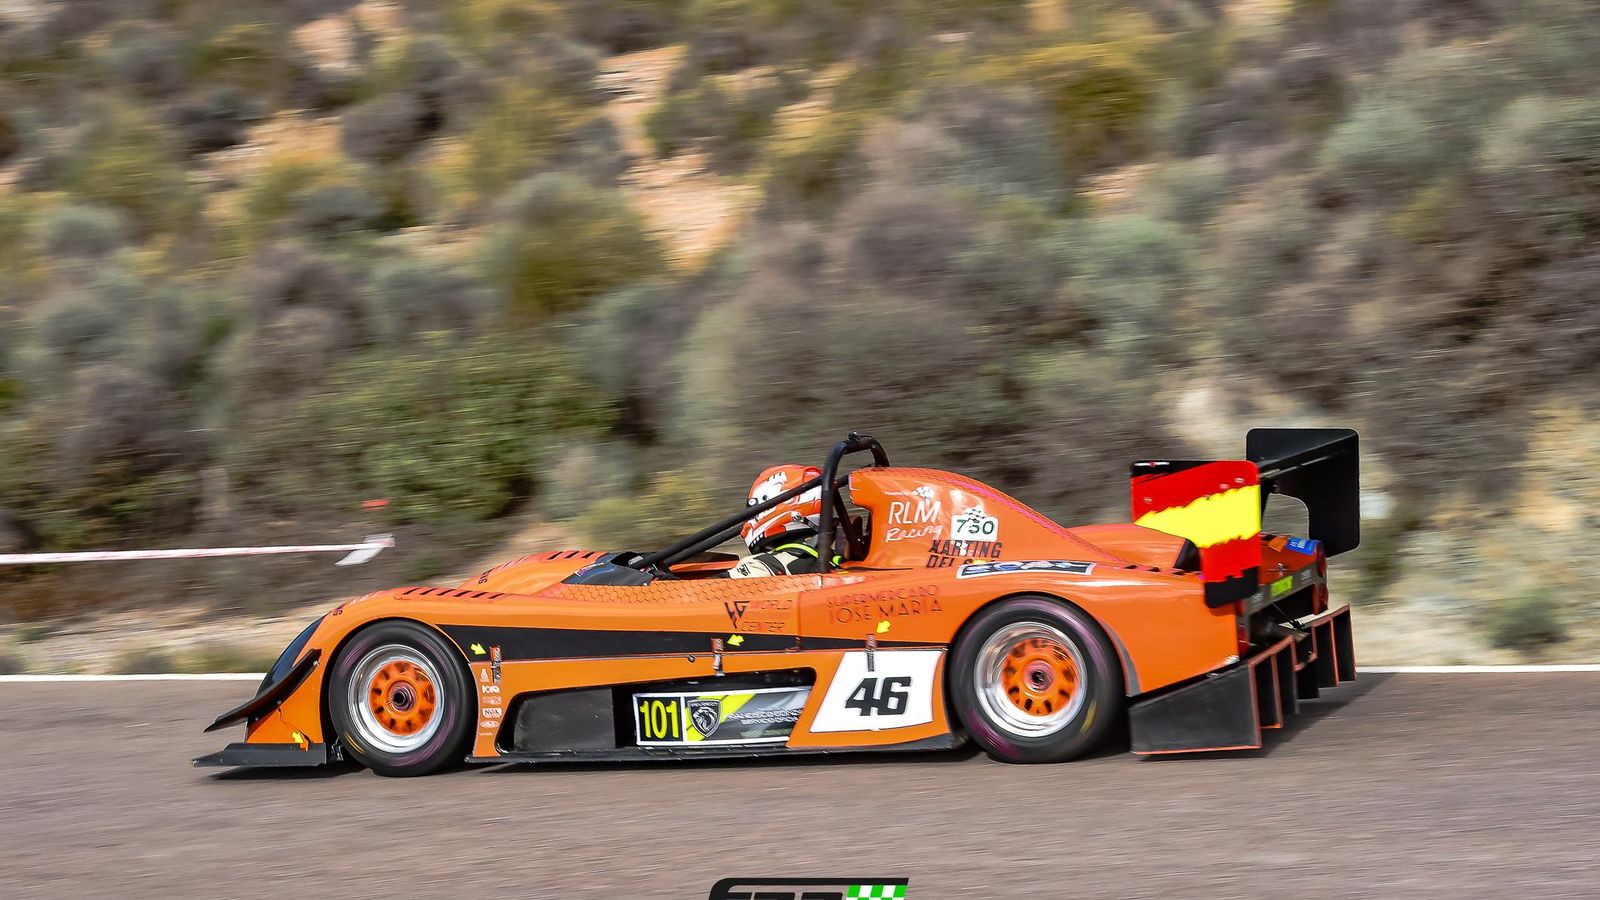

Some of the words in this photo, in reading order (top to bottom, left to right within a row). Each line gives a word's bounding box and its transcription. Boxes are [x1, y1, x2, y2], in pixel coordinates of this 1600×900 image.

[888, 501, 941, 525] RLM
[957, 519, 994, 535] 730
[928, 540, 1003, 559] KARTING
[926, 555, 955, 568] DEL
[845, 676, 911, 716] 46
[640, 700, 679, 738] 101
